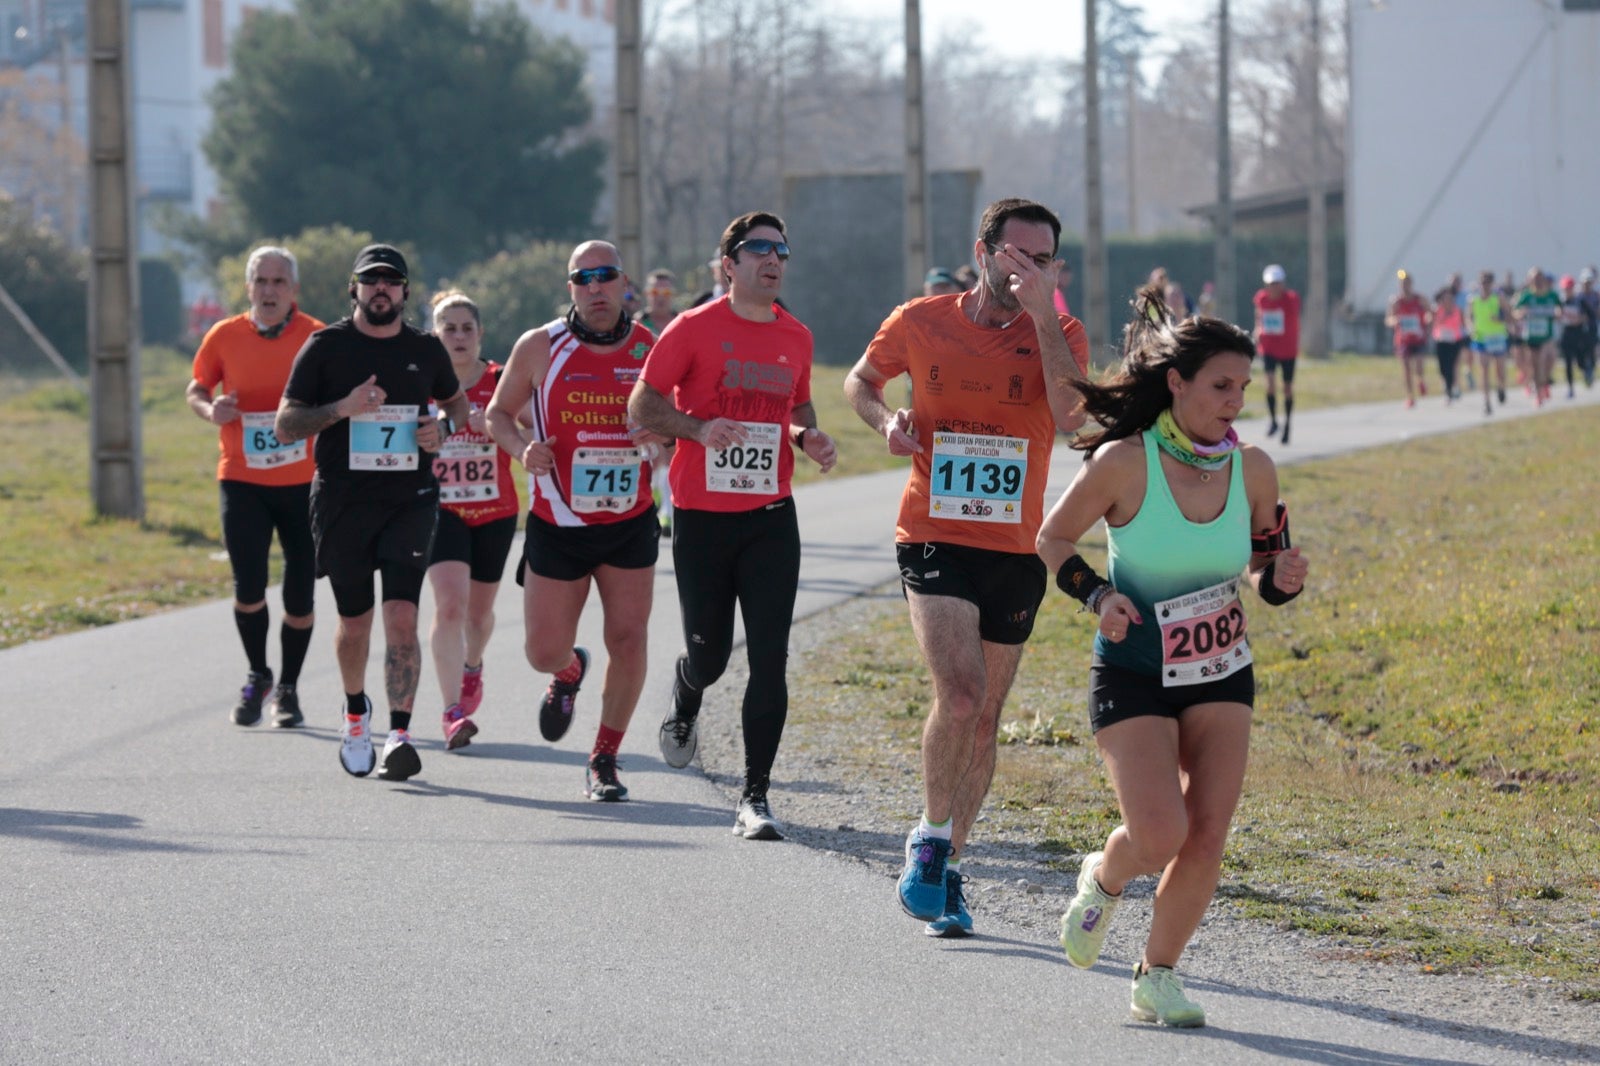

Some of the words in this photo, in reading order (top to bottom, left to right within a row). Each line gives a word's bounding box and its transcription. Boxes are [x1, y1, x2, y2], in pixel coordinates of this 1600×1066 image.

[560, 410, 628, 425] Polisal
[952, 419, 1005, 435] PREMIO
[254, 430, 296, 451] 63
[380, 426, 396, 450] 7
[957, 436, 974, 447] GRAN
[974, 437, 997, 448] PREMIO
[997, 439, 1004, 449] DE
[714, 446, 773, 471] 3025
[436, 460, 494, 483] 2182
[585, 468, 632, 493] 715
[938, 460, 1021, 495] 1139
[1169, 607, 1243, 660] 2082
